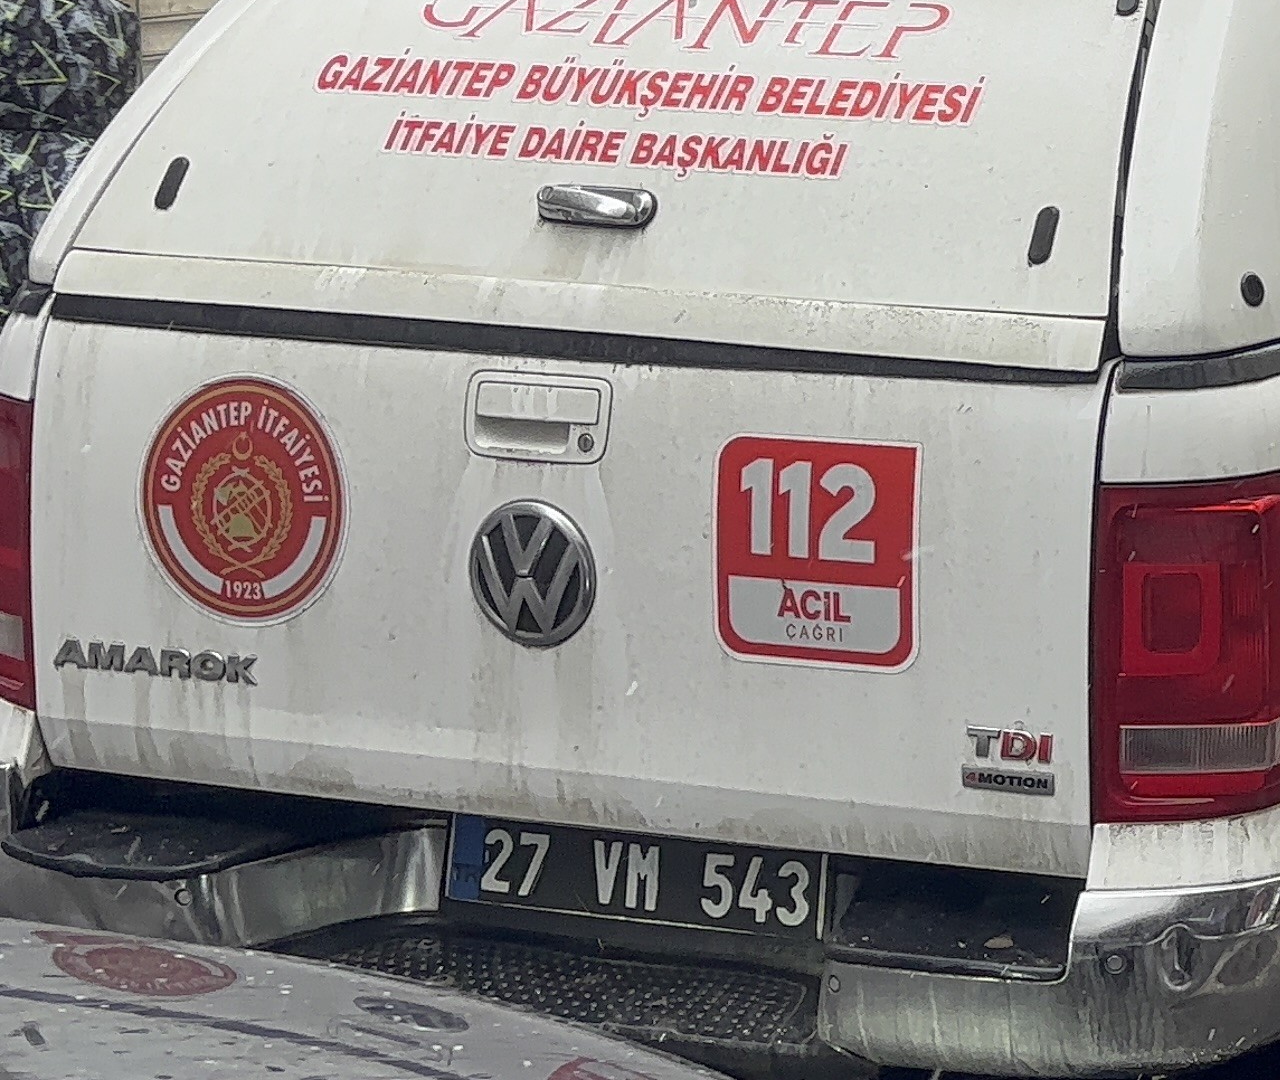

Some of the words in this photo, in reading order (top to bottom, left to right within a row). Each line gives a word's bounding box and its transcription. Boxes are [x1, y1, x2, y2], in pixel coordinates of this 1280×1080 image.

[316, 48, 513, 97] GAZİANTEP
[520, 57, 755, 118] BÜYÜKŞEHİR
[763, 73, 986, 124] BELEDİYESİ
[384, 116, 516, 158] İTFAİYE
[518, 121, 628, 163] DAİRE
[630, 130, 850, 176] BAŞKANLIĞI
[160, 401, 252, 492] GAZİANTEP
[257, 398, 329, 503] İTFAİYESİ
[740, 457, 876, 564] 112
[225, 580, 262, 600] 1923
[785, 624, 844, 643] ÇAĞRI
[53, 639, 259, 686] AMAROK
[966, 724, 1054, 764] TDI
[964, 770, 1049, 791] 4MOTION
[480, 828, 551, 897] 27
[592, 839, 661, 912] VM
[700, 852, 811, 927] 543
